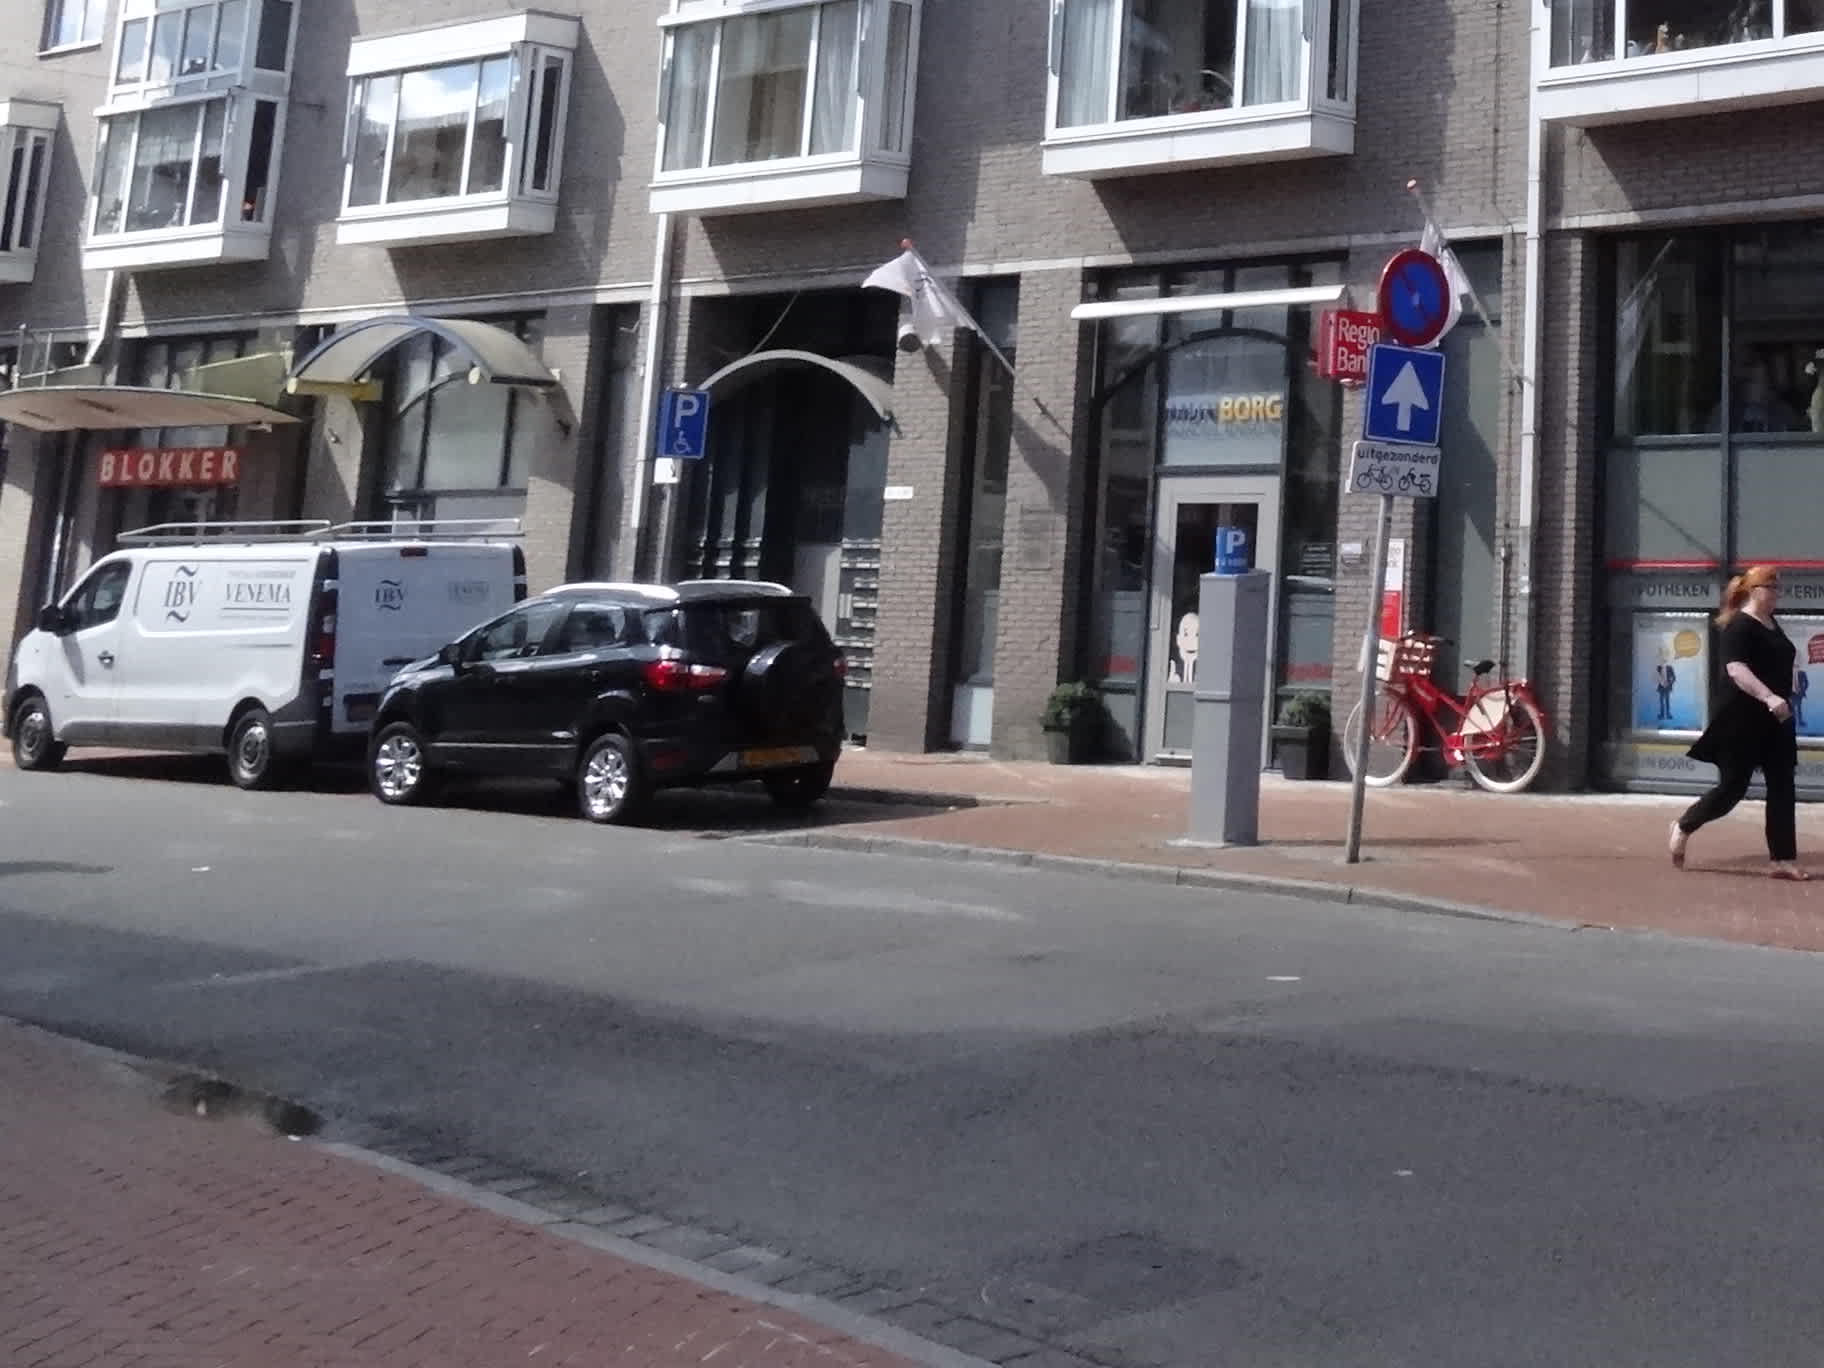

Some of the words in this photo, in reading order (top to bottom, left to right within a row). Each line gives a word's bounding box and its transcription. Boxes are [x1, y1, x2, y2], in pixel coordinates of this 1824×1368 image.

[1338, 318, 1380, 350] Regio
[1337, 347, 1367, 373] Ban
[674, 394, 700, 428] P
[1220, 395, 1282, 422] BORG
[100, 450, 238, 482] BLOKKER
[1357, 448, 1439, 465] uitgezonderd
[1225, 530, 1246, 554] P
[164, 580, 198, 608] IBV
[226, 582, 292, 603] VENEMA
